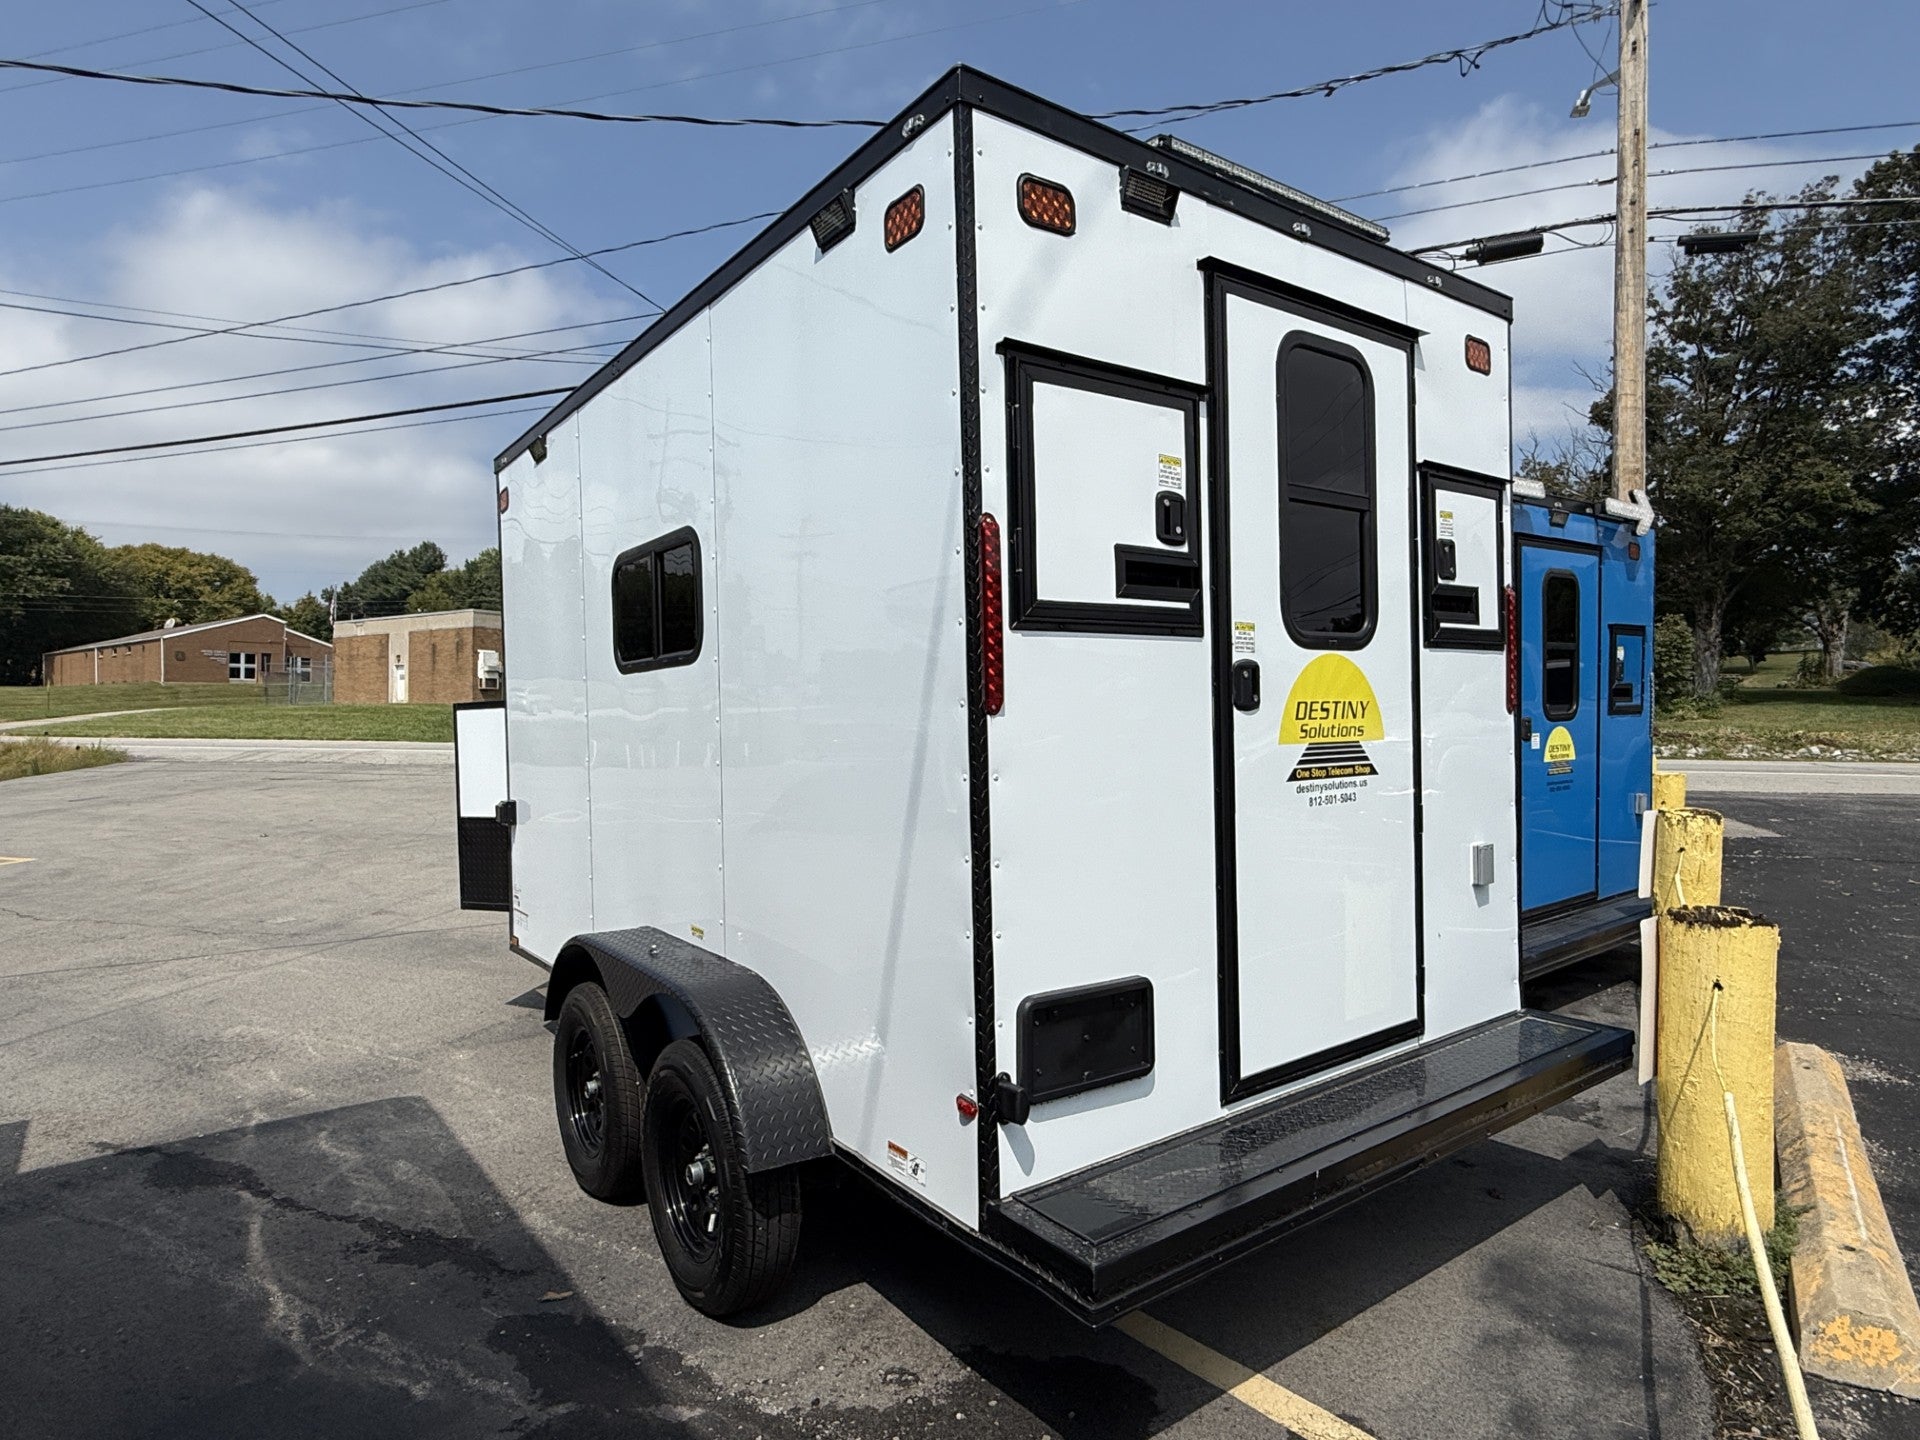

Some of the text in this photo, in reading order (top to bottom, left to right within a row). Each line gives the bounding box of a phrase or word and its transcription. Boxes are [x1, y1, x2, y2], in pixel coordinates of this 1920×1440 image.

[1295, 701, 1369, 720] DESTINY
[1299, 723, 1364, 738] Solutions
[1548, 744, 1571, 753] DESTINY
[1296, 764, 1370, 778] One Stop Telecom Shop
[1296, 779, 1367, 793] destinysolutions.us
[1309, 792, 1356, 806] 812-501-5043
